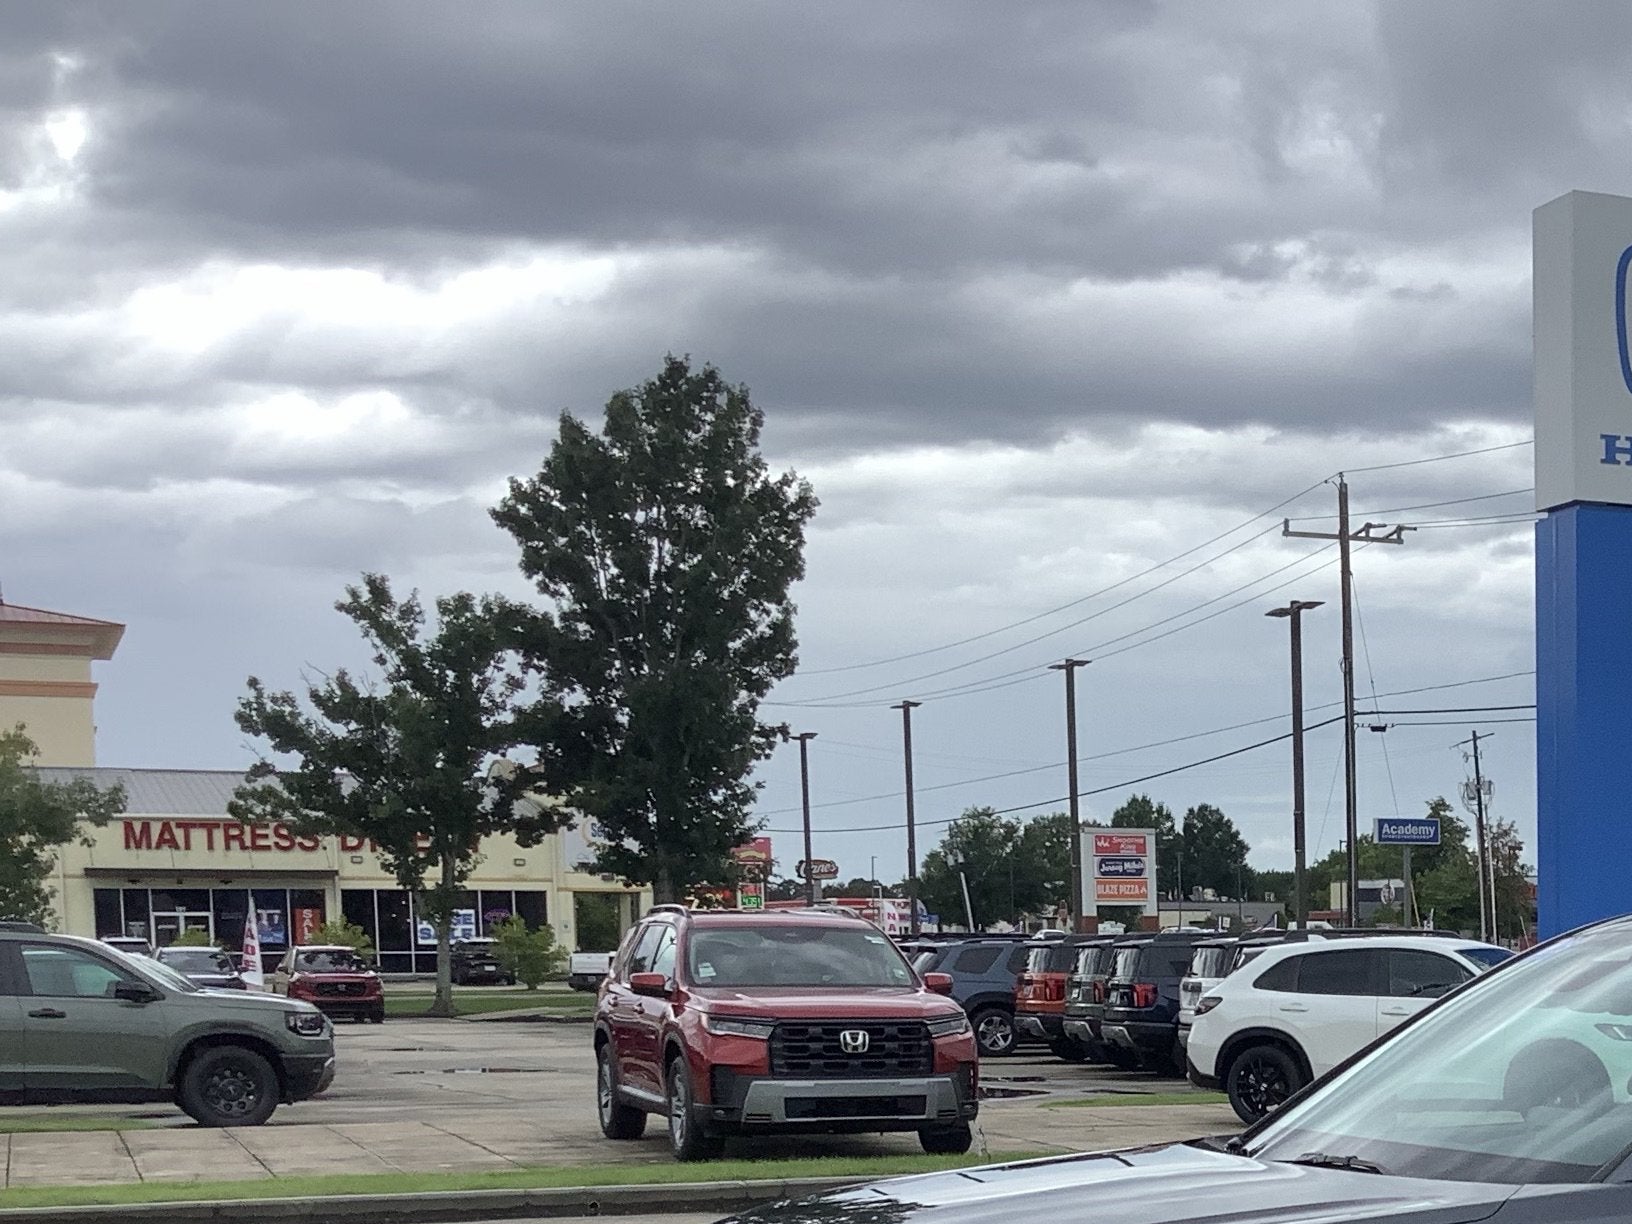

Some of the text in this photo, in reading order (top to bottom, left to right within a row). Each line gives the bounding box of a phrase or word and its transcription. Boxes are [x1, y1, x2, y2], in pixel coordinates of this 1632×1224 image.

[123, 821, 320, 852] MATTRESS
[1382, 823, 1436, 838] Academy
[419, 927, 474, 941] SLE
